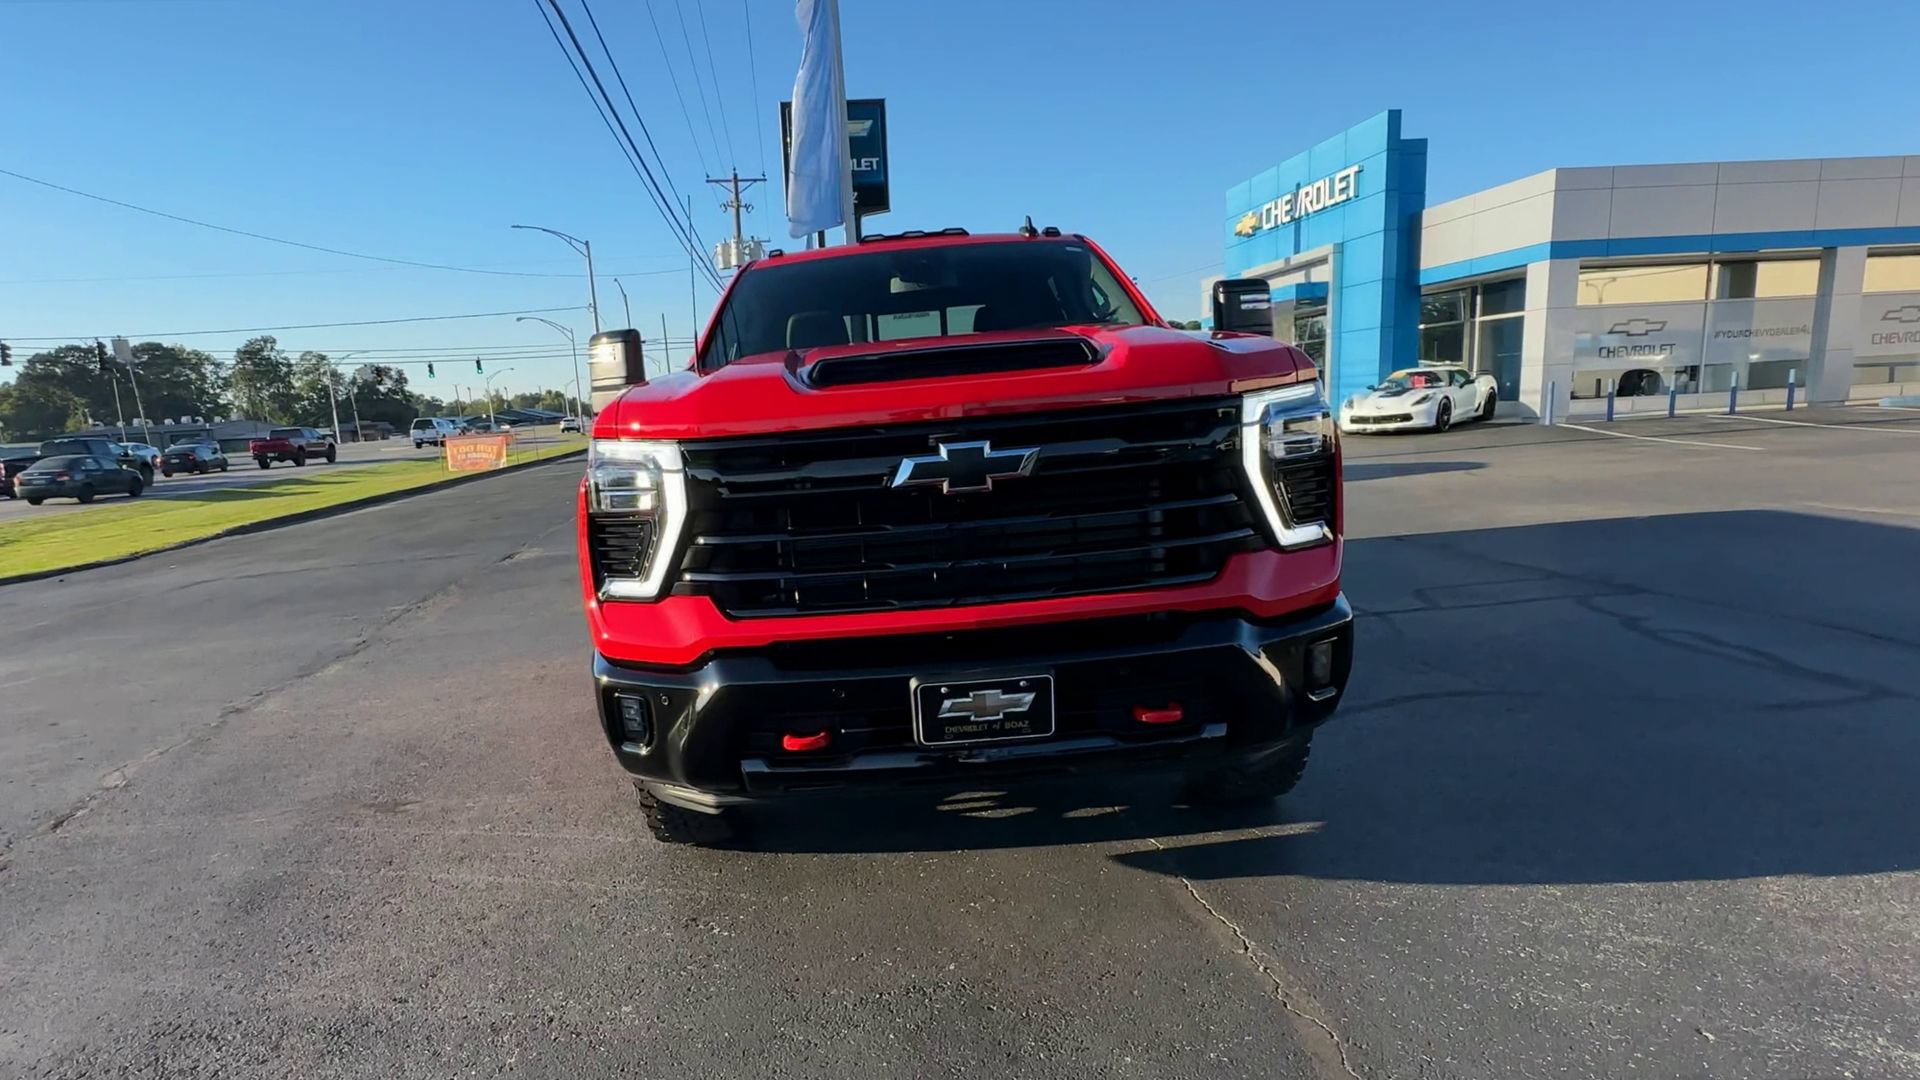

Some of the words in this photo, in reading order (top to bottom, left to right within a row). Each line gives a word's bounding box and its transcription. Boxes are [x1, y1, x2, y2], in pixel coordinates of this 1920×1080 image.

[851, 158, 880, 171] LET
[1262, 164, 1361, 230] CHEVROLET
[1598, 343, 1676, 358] CHEVROLET
[945, 723, 988, 733] CHEVROLET
[1005, 720, 1030, 729] BOAZ
